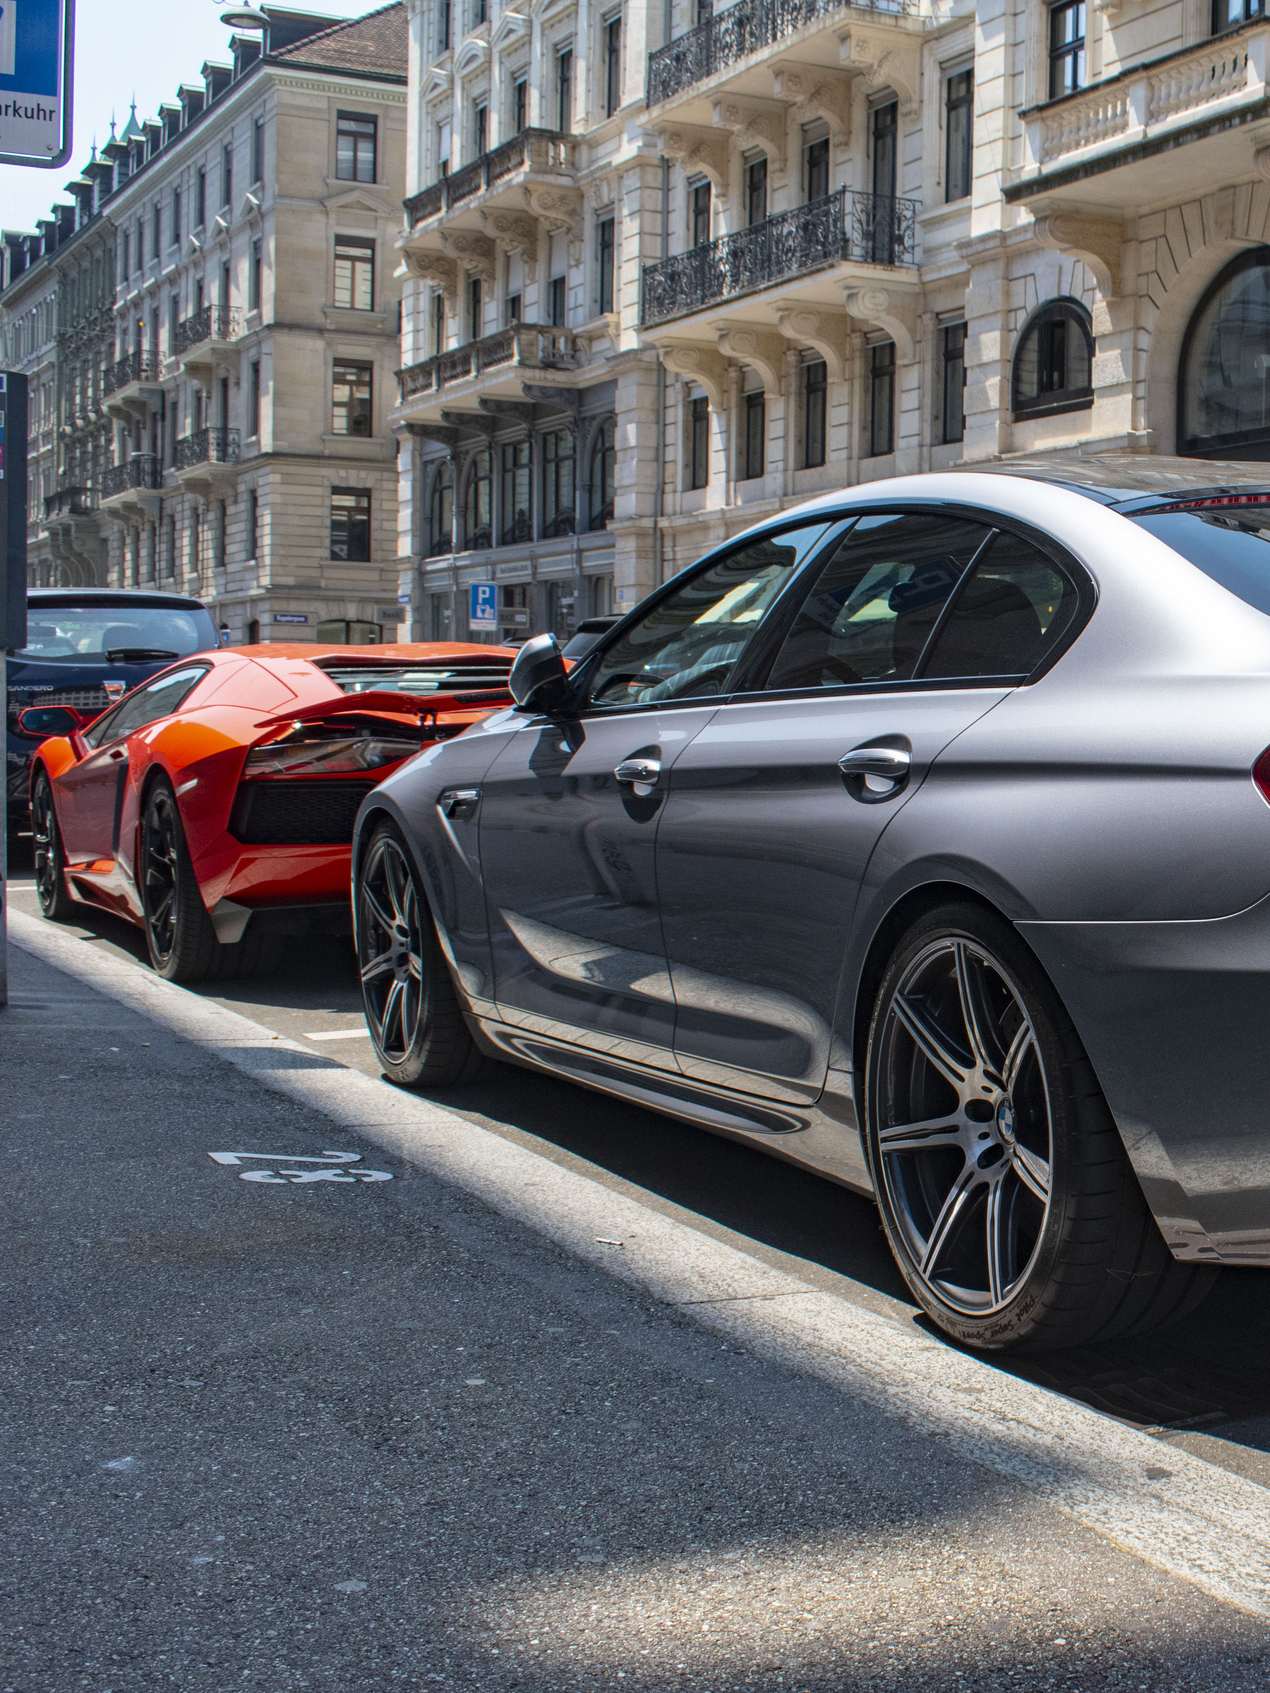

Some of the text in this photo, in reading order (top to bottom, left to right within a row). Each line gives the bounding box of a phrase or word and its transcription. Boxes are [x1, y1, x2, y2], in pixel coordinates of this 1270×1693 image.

[0, 100, 55, 122] rkuhr
[478, 586, 490, 603] P
[961, 1293, 1037, 1341] Pilot Super Sport
